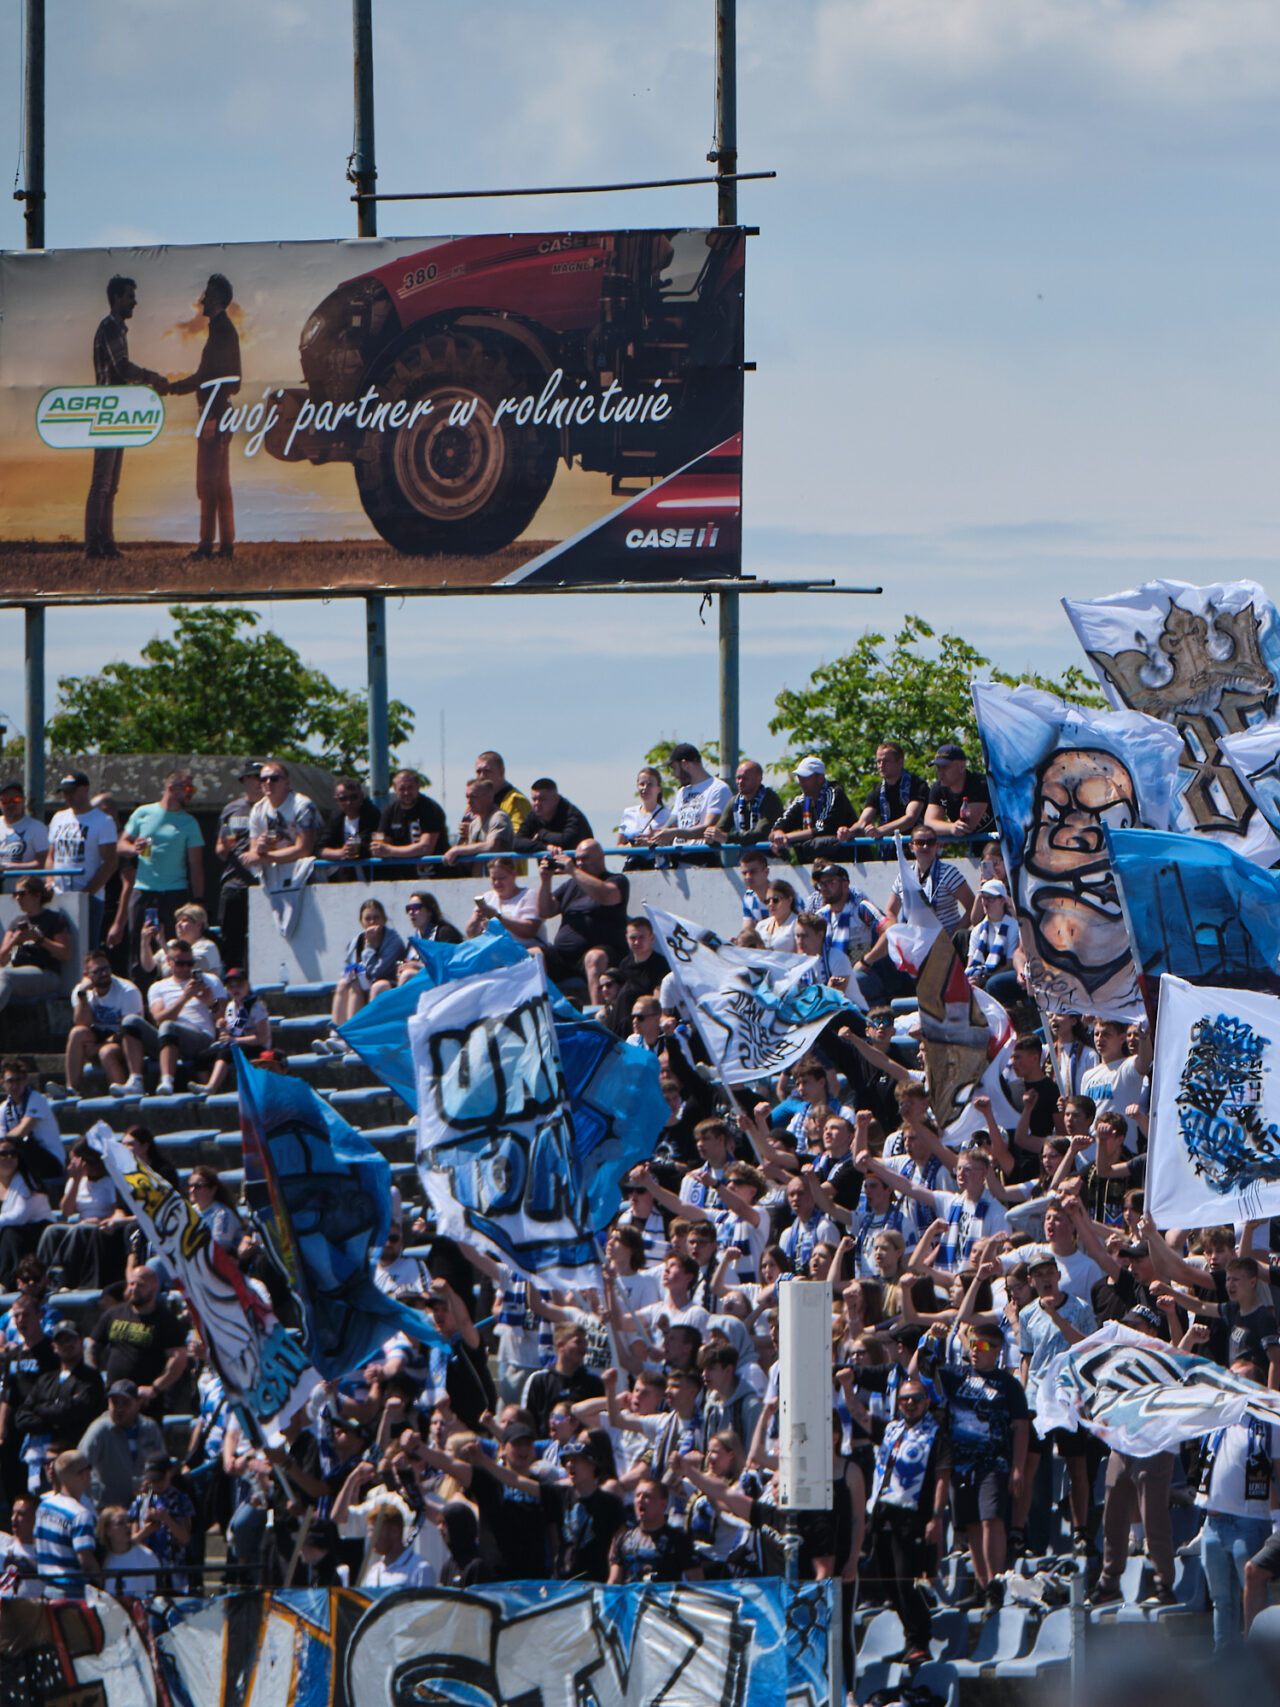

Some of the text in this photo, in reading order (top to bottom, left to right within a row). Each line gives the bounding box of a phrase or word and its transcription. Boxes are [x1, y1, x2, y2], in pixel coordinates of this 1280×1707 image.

[403, 263, 438, 290] 380
[48, 396, 120, 411] AGRO
[195, 368, 672, 457] Twój partner w rolnictwie
[97, 410, 161, 424] RAMI
[625, 528, 695, 549] CASE
